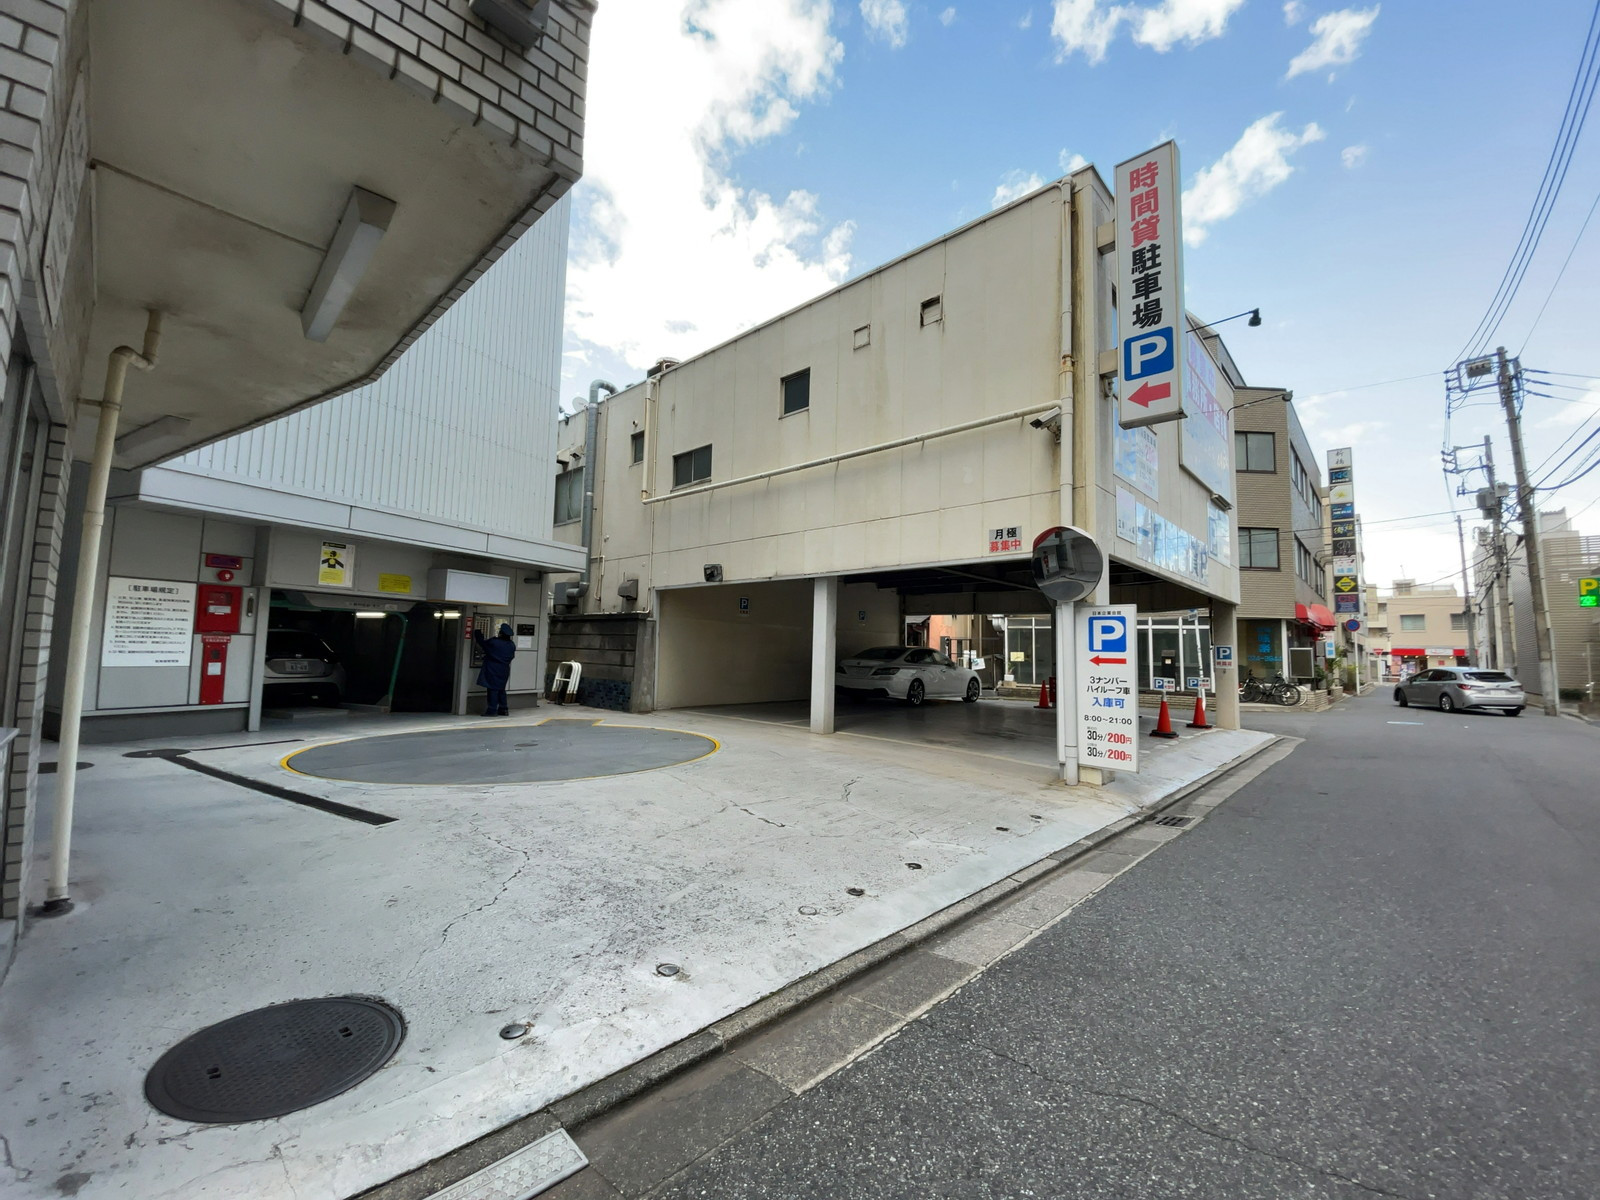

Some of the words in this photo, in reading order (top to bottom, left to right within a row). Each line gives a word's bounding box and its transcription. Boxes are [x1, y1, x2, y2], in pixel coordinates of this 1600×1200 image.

[1129, 161, 1163, 329] 時間貸駐車場
[1130, 335, 1167, 376] P
[994, 527, 1017, 540] 月極
[989, 538, 1021, 553] 募集中
[1580, 579, 1598, 595] P
[1092, 619, 1125, 651] P
[1219, 648, 1230, 659] P
[1089, 676, 1128, 686] 3ナンバー
[1086, 685, 1131, 696] ハイルーフ車
[1092, 697, 1126, 709] 入庫可
